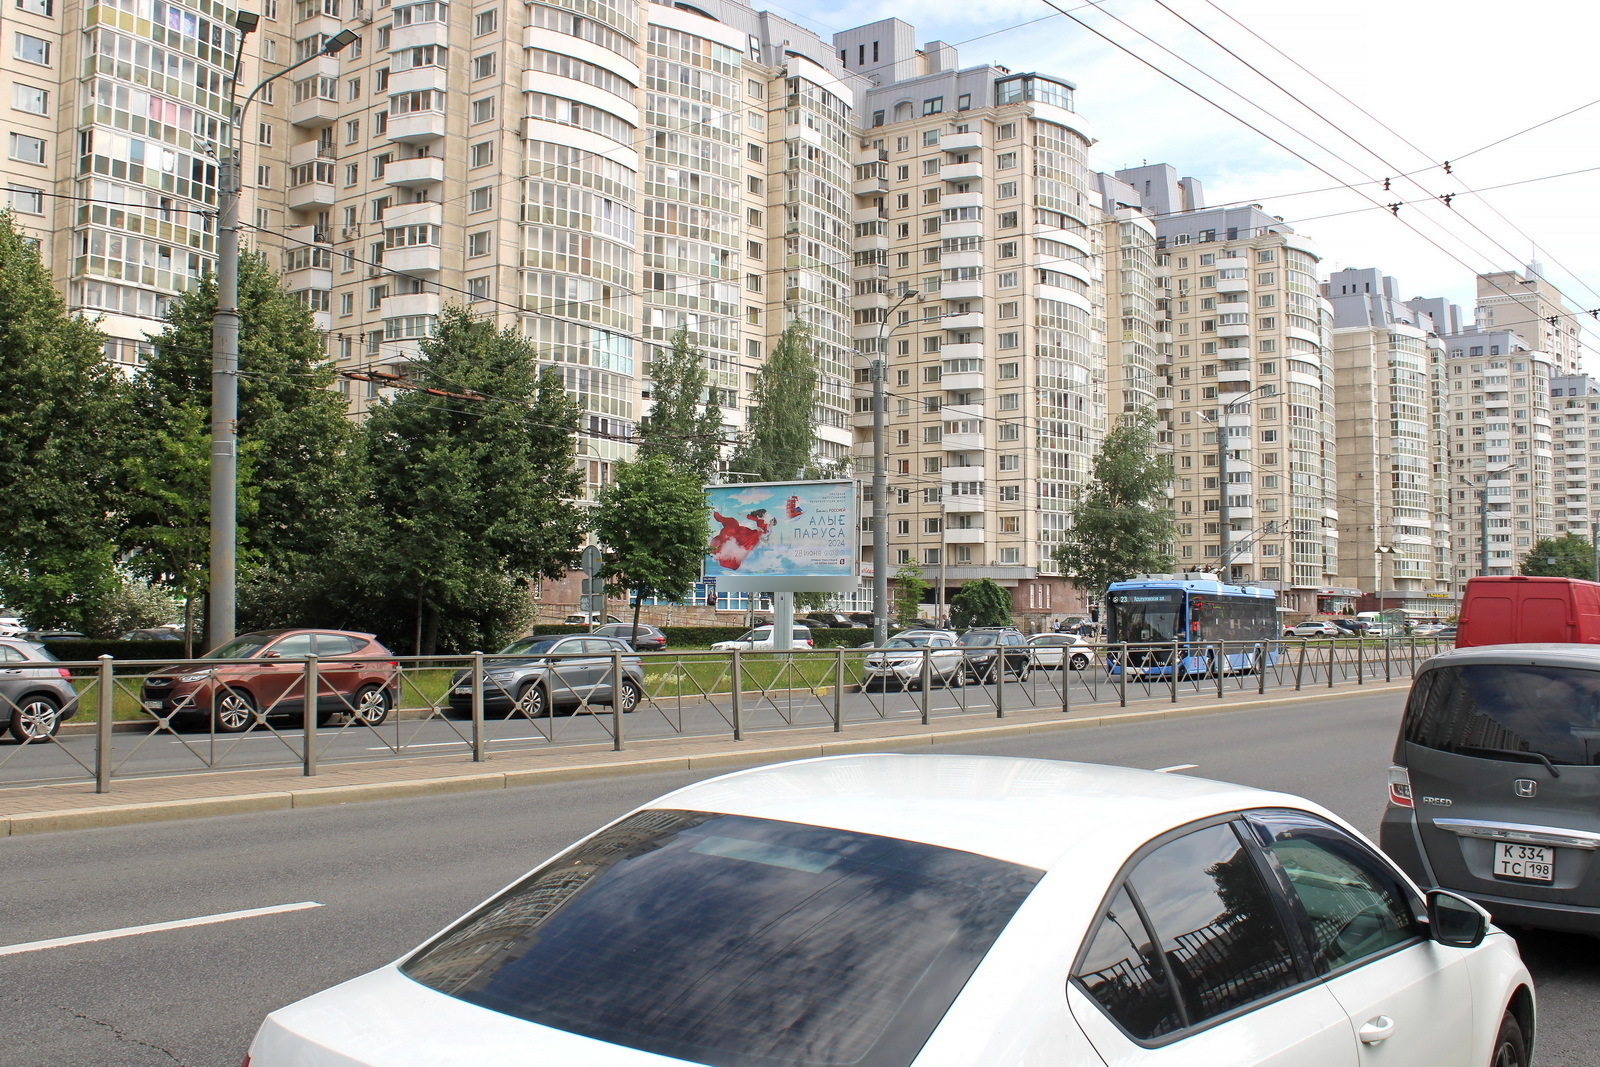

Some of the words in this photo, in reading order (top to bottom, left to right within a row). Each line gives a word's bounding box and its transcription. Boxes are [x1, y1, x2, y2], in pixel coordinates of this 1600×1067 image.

[809, 515, 845, 525] АЛЫЕ
[794, 528, 845, 538] ПАРУСА
[794, 549, 803, 557] 28
[1422, 796, 1453, 807] FREED
[1504, 845, 1514, 858] К
[1518, 846, 1544, 861] 334
[1501, 860, 1522, 875] ТС
[1529, 863, 1549, 875] 198
